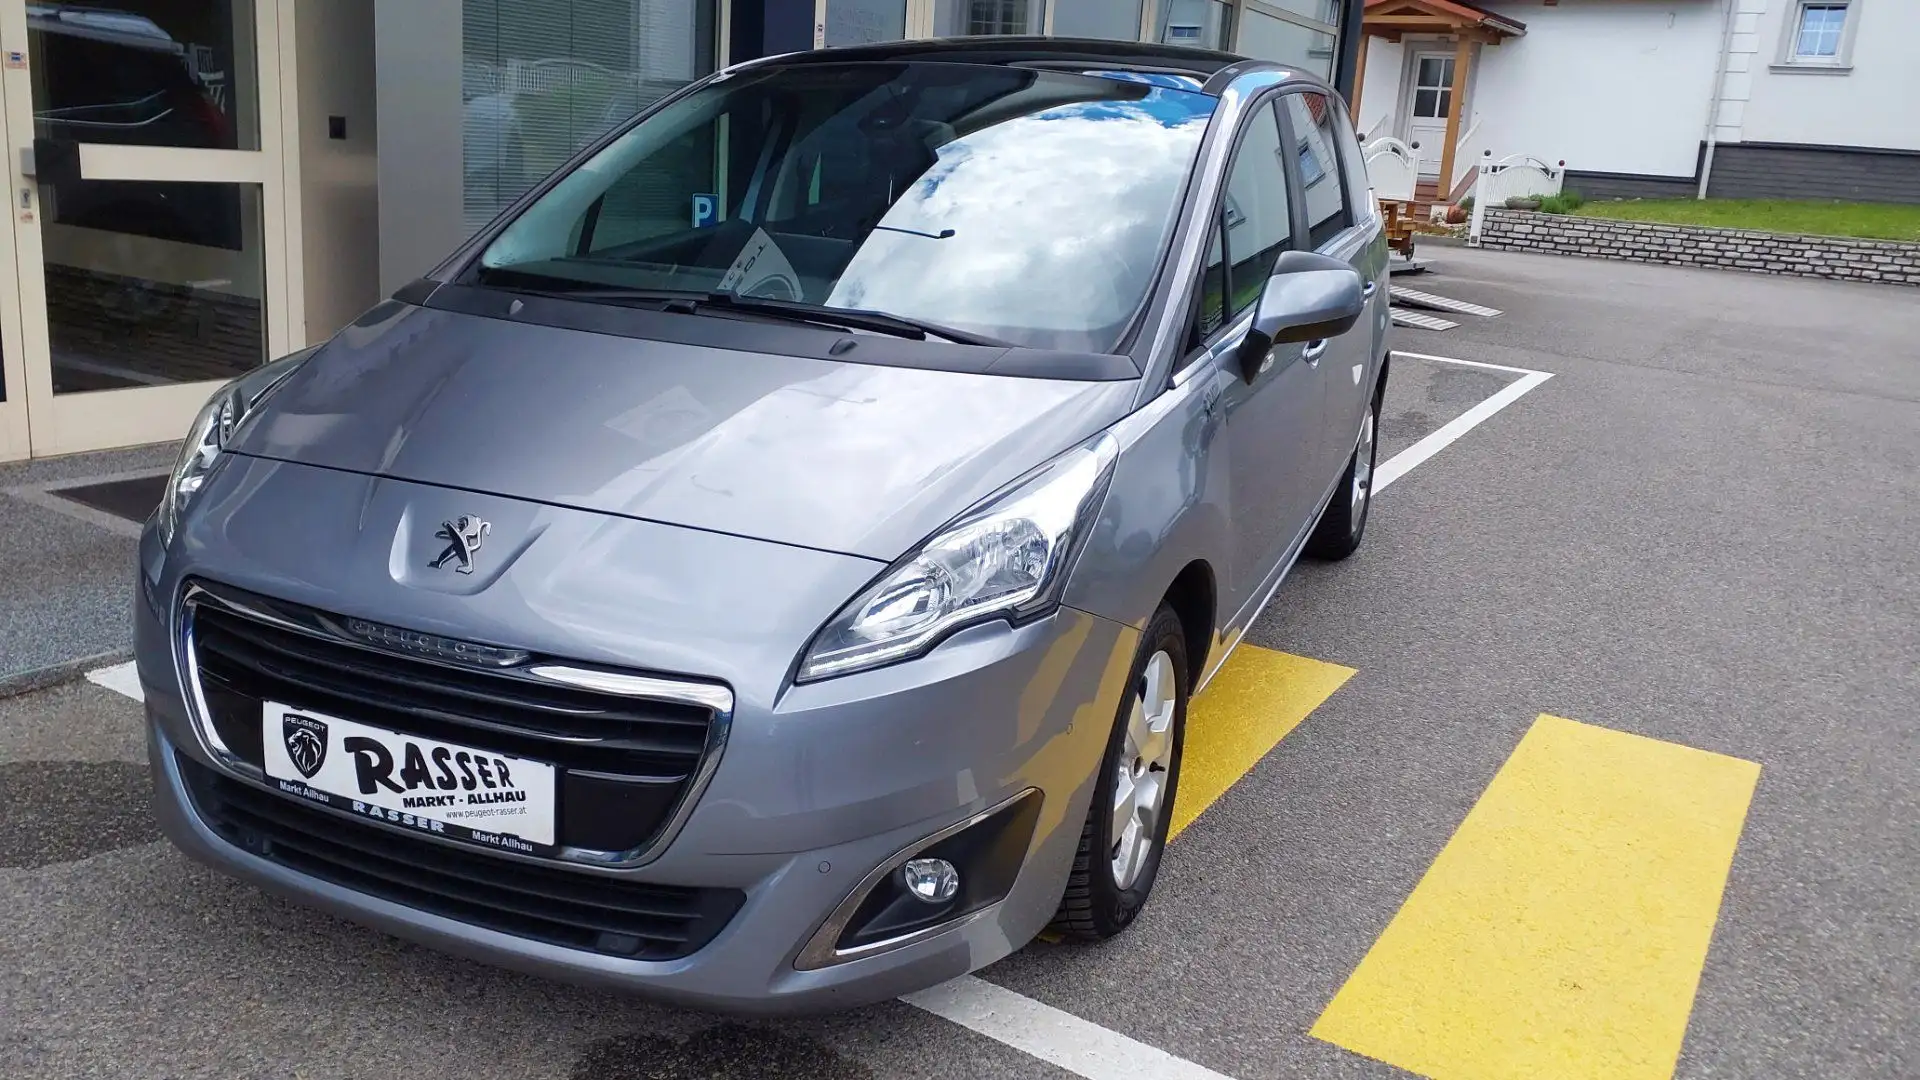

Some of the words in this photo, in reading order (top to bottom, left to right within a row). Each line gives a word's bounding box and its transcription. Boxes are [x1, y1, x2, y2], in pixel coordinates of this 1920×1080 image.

[694, 197, 713, 228] P
[284, 716, 326, 732] PEUGEOT
[343, 736, 514, 794] RASSER
[279, 780, 302, 795] Markt
[302, 787, 329, 803] Allhau
[402, 795, 456, 808] MARKT
[467, 790, 526, 805] ALLHAU
[352, 800, 445, 833] RASSER
[445, 805, 527, 820] www.peugeot-rasser.at
[471, 830, 500, 845] Markt
[500, 837, 533, 852] Allhau
